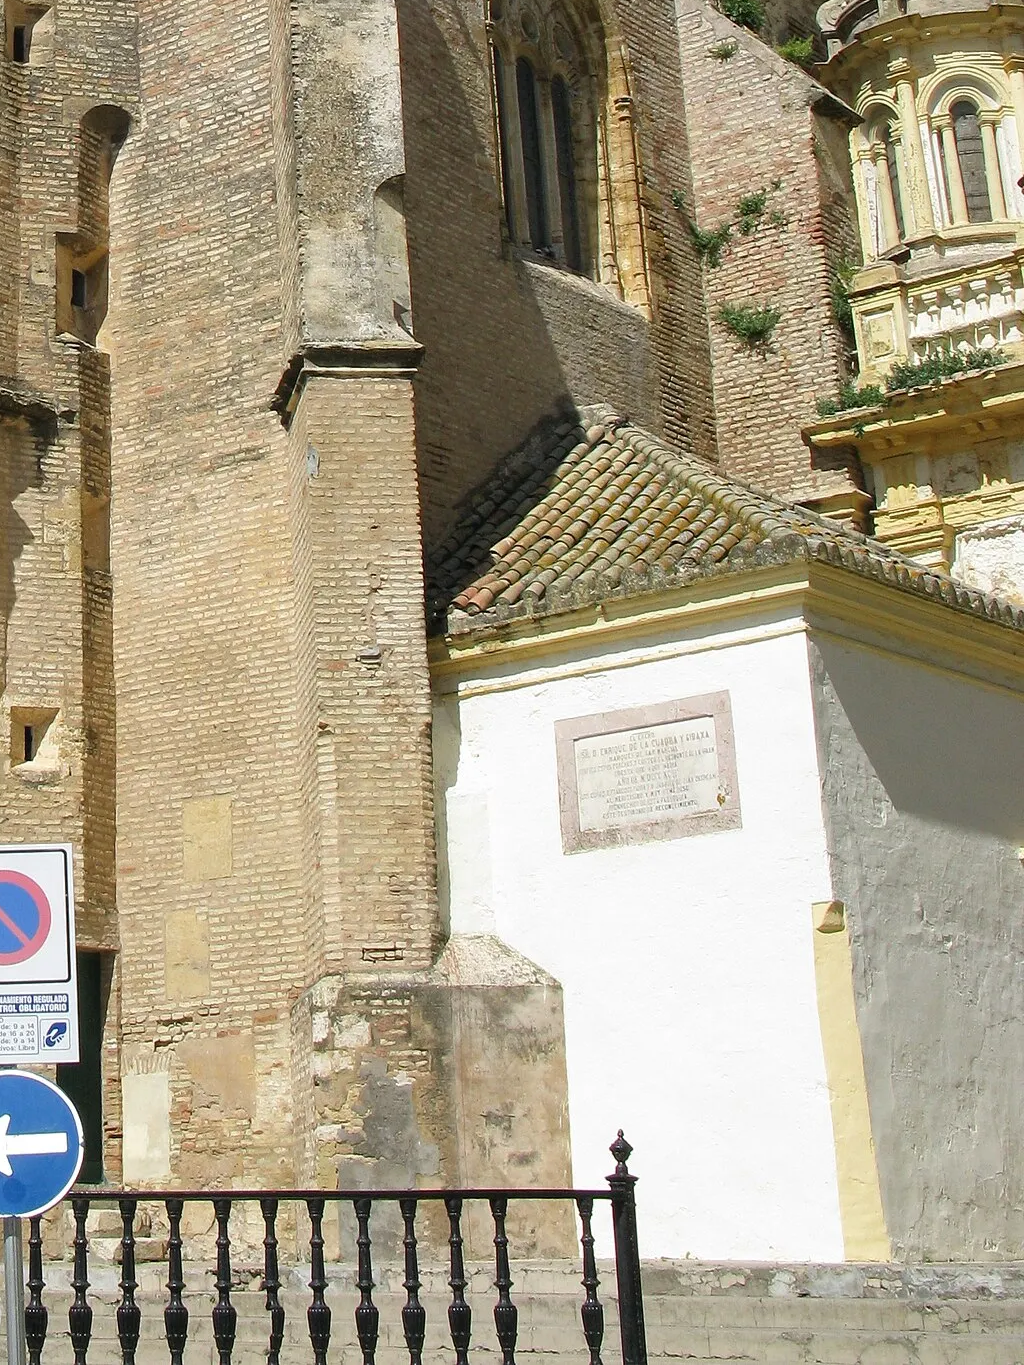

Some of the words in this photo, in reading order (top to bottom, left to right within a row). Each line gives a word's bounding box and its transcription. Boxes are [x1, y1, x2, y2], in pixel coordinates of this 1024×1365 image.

[600, 744, 626, 756] ENRIQUE
[33, 995, 67, 1003] REGULADO
[19, 1003, 67, 1012] OBLIGATORIO
